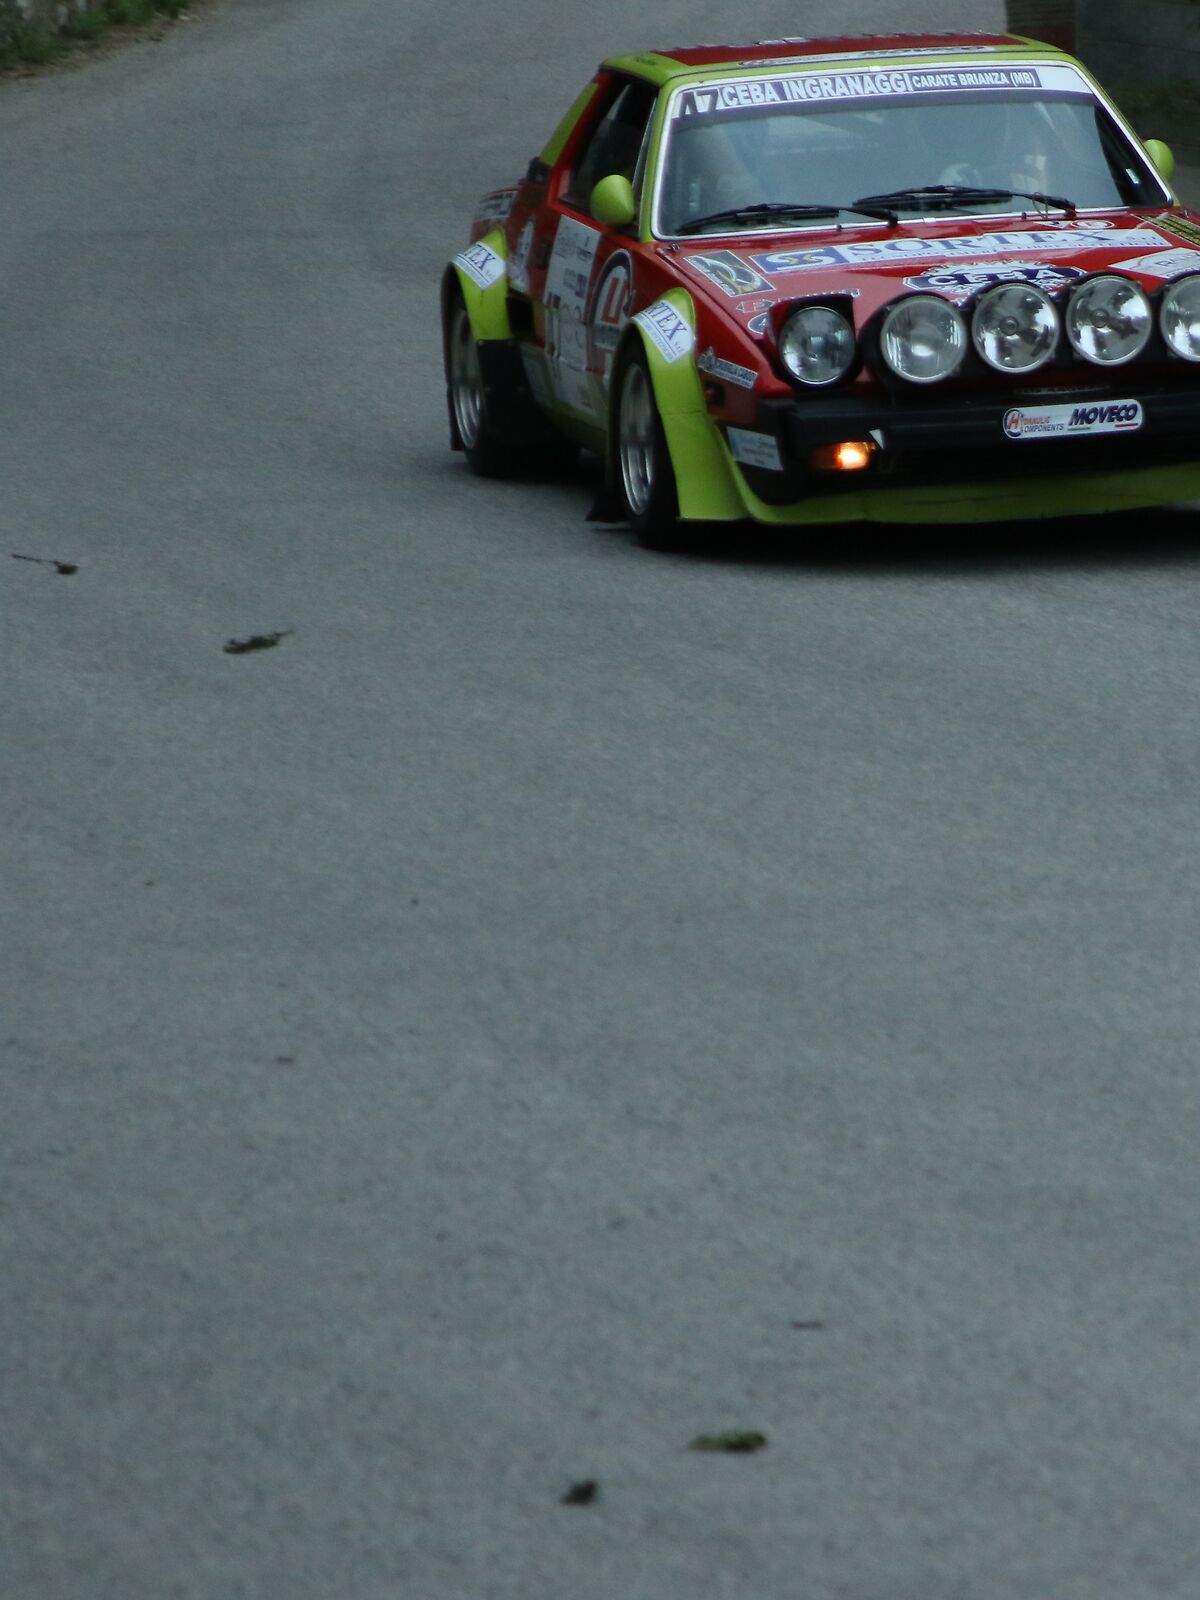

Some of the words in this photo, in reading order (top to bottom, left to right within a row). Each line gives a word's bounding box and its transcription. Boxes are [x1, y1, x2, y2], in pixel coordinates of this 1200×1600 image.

[720, 82, 780, 107] CEBA
[782, 73, 914, 100] INGRANAGGI
[912, 74, 957, 89] CARATE
[960, 72, 1009, 86] BRIANZA
[1011, 71, 1035, 87] (MB)
[847, 231, 1113, 256] SORTEX
[927, 268, 1064, 285] CEBA
[1068, 403, 1138, 426] MOVECO
